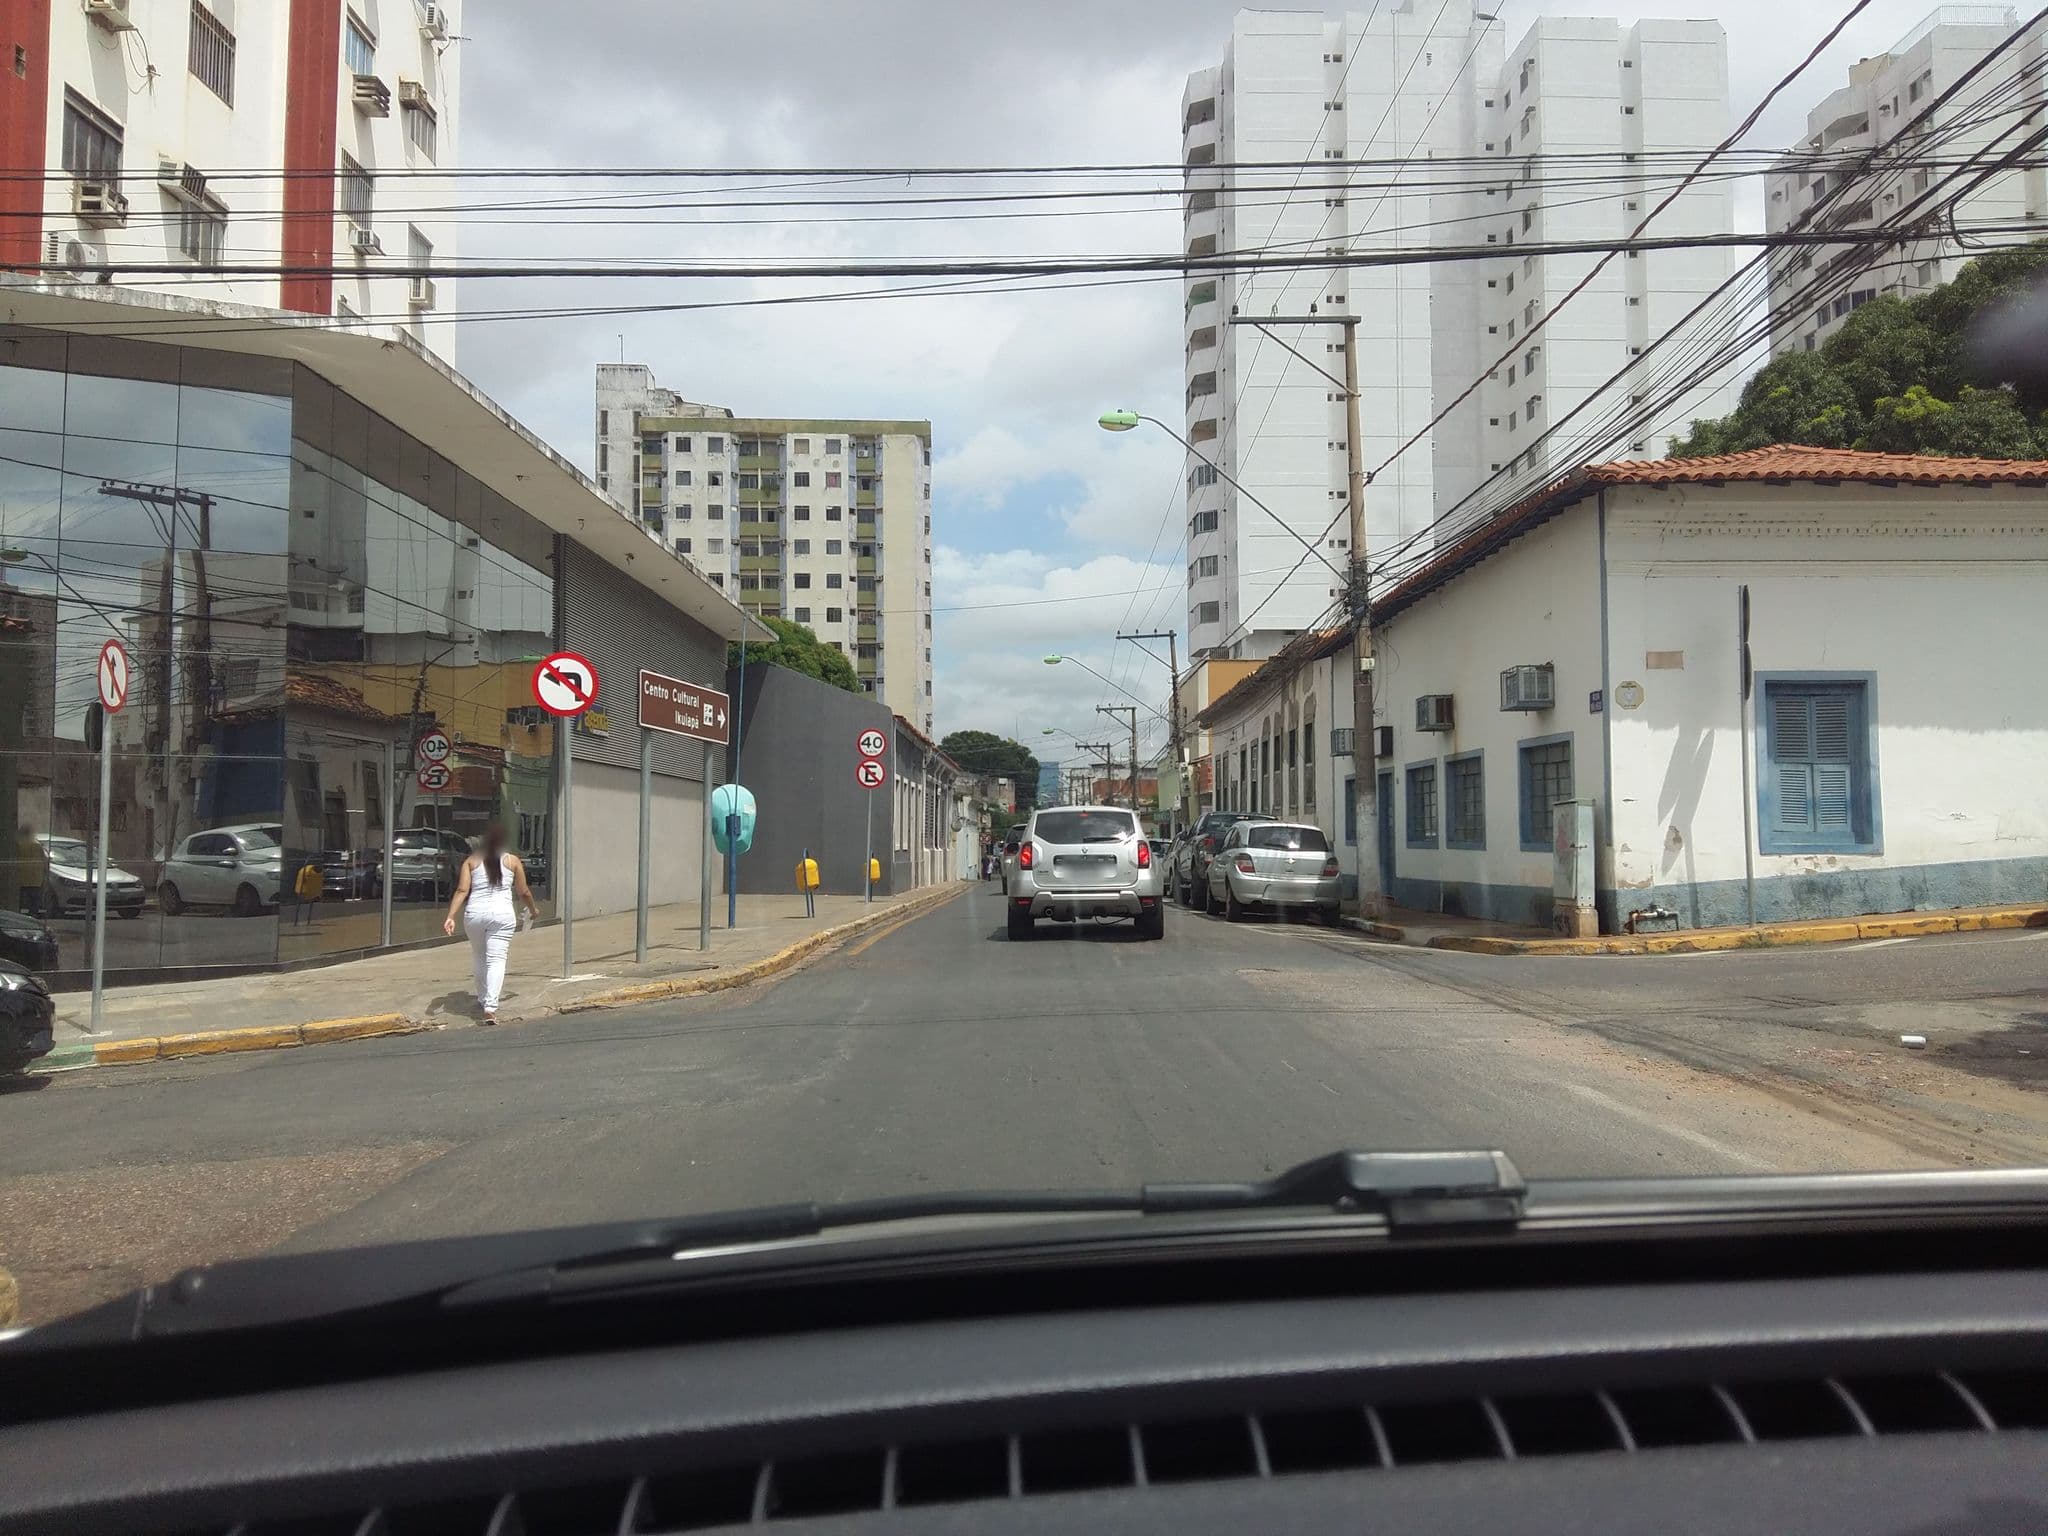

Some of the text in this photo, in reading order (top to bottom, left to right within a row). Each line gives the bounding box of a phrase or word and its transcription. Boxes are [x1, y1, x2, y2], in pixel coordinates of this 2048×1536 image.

[644, 680, 700, 708] Centro Cultural
[861, 736, 883, 749] 40
[865, 764, 878, 783] E
